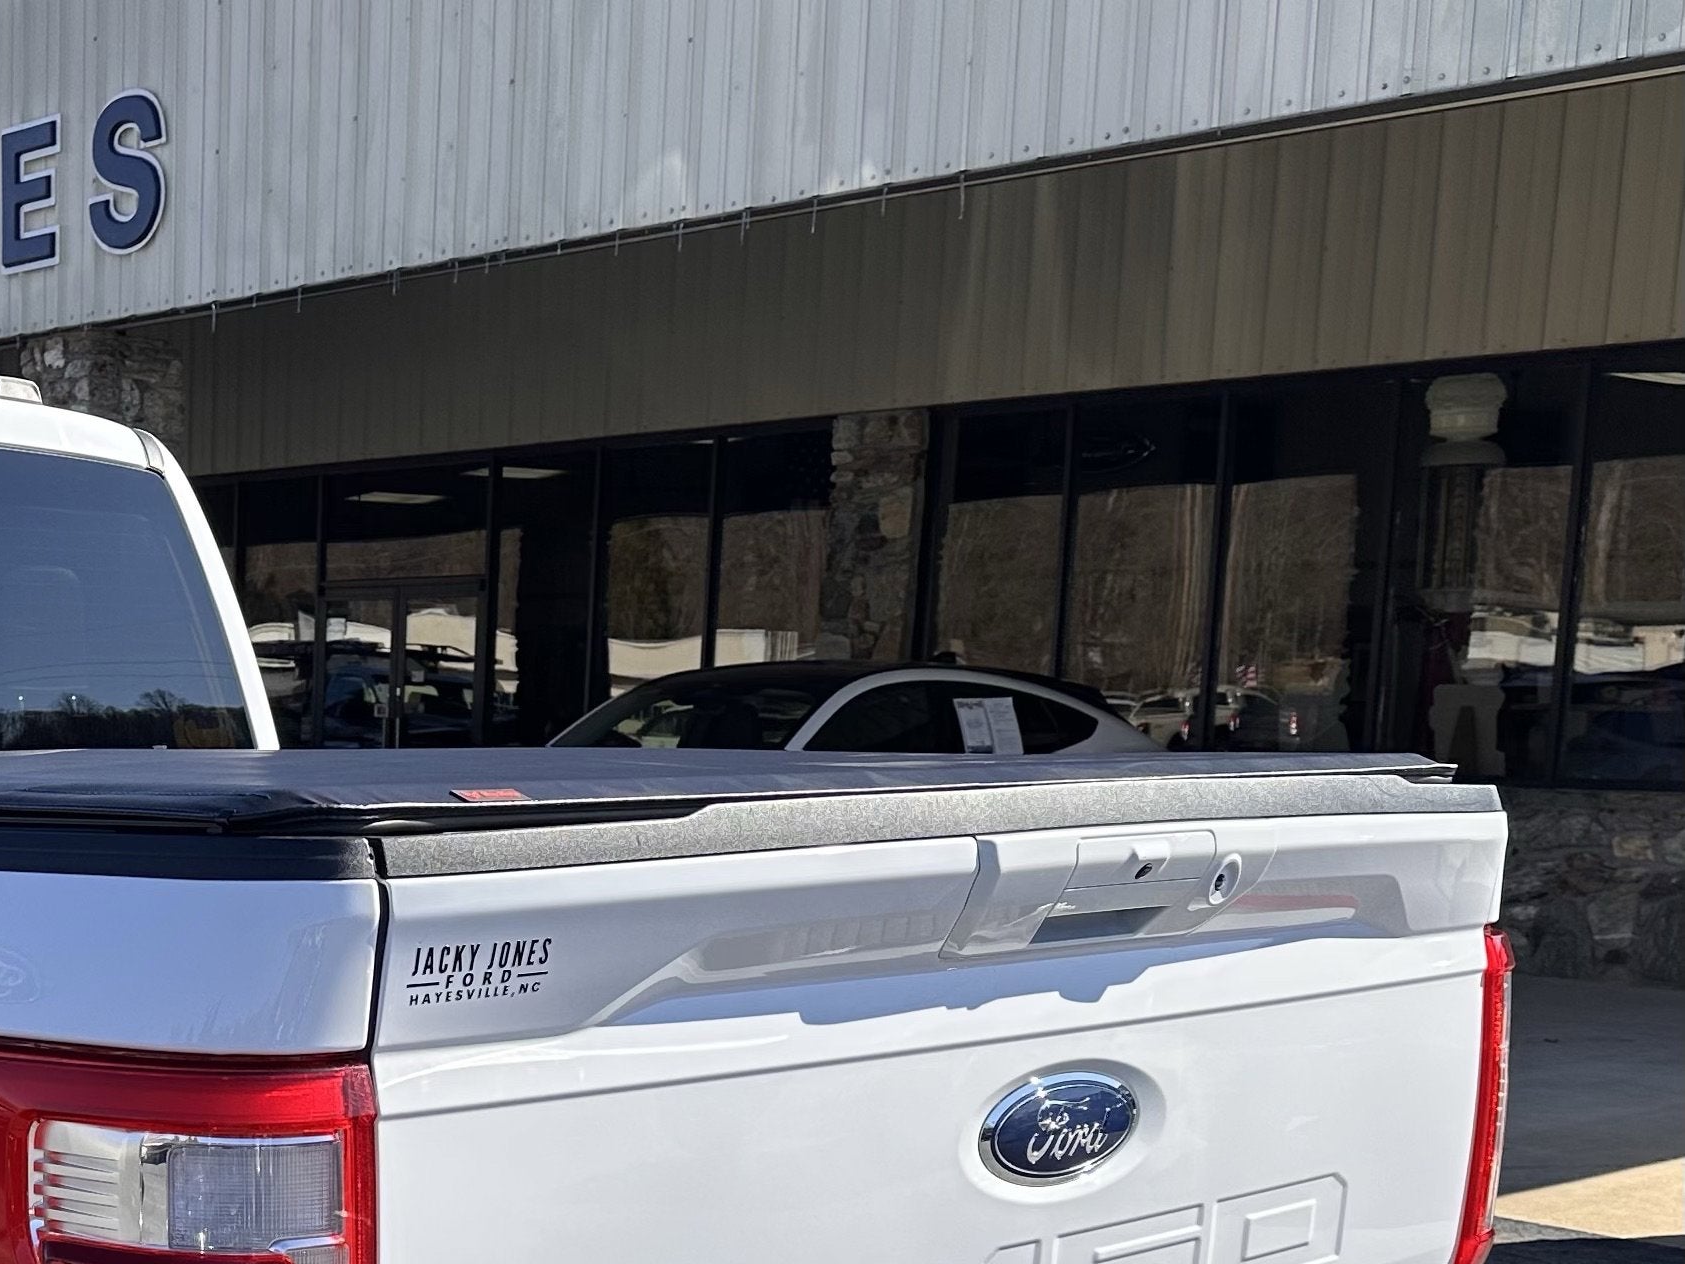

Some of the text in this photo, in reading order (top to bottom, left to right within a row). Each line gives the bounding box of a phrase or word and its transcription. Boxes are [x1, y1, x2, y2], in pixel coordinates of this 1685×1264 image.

[411, 937, 553, 977] JACKY JONES
[445, 969, 512, 989] FORD
[1026, 1096, 1112, 1165] Ford
